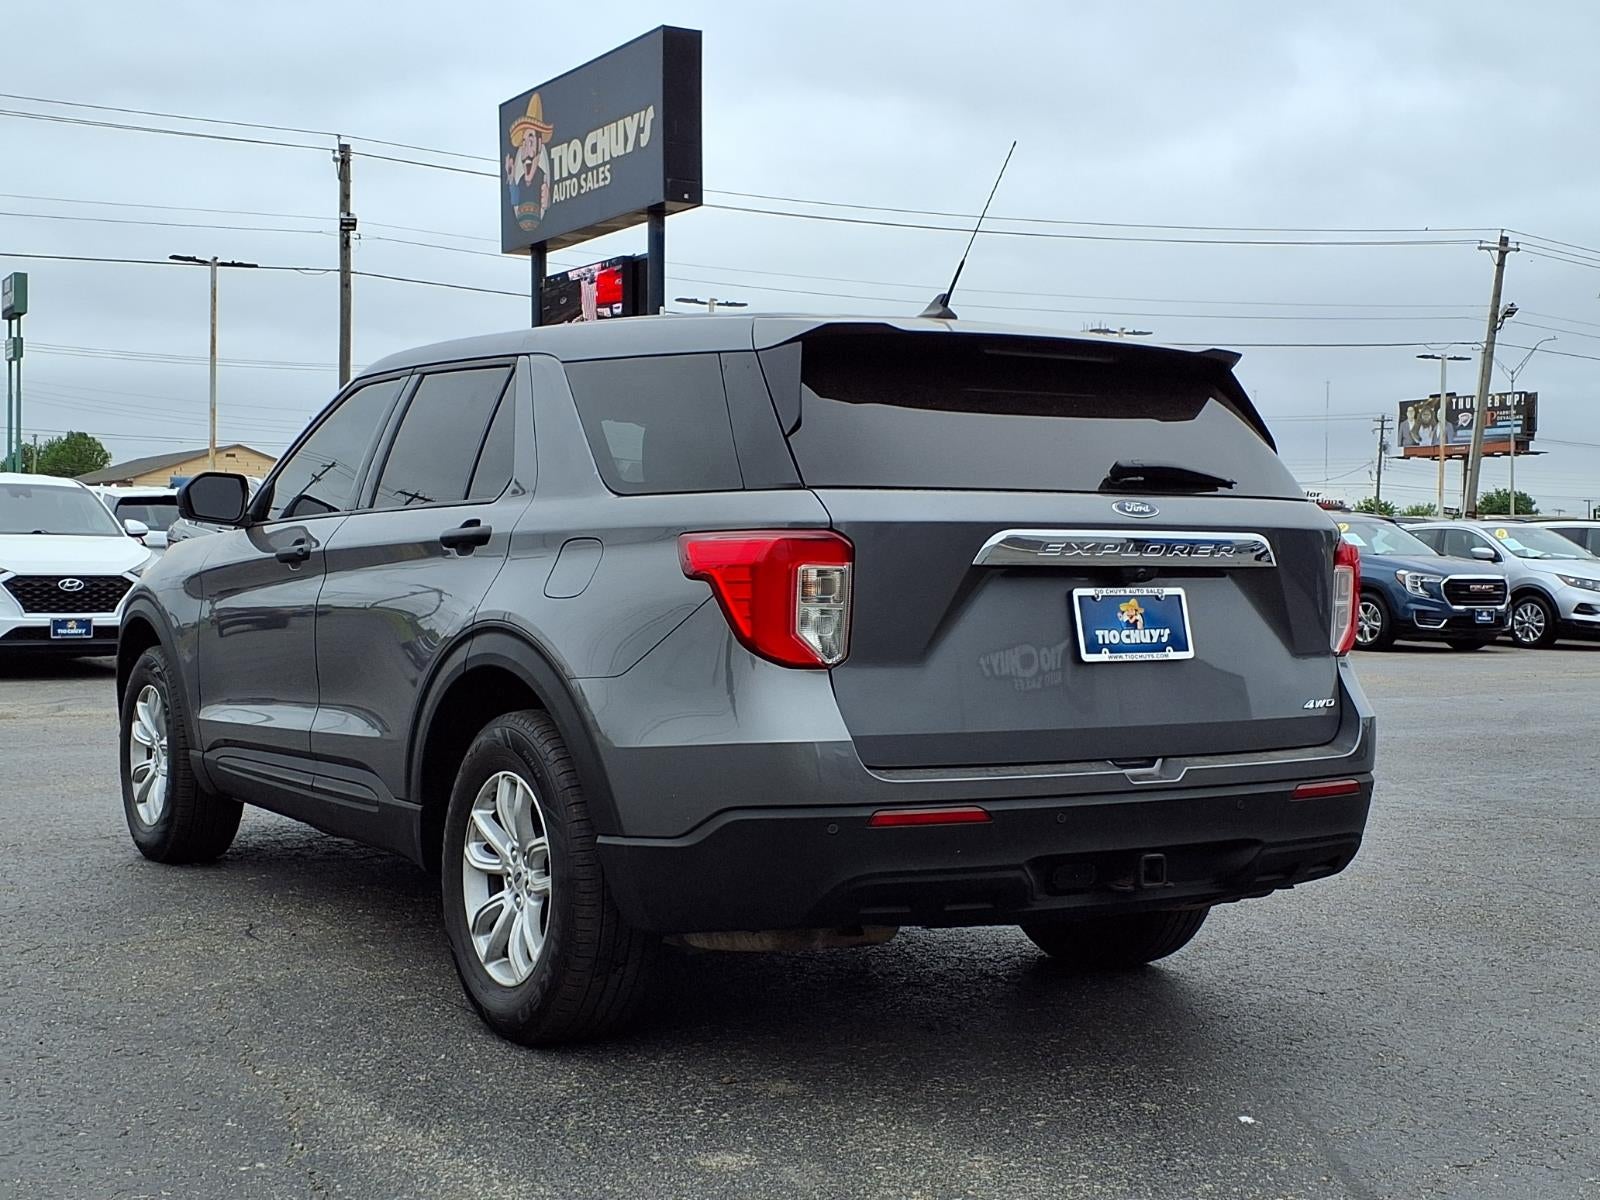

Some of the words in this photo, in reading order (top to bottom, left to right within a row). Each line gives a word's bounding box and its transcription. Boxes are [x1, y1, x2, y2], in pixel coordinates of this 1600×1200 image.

[550, 138, 583, 181] TIO
[583, 104, 655, 168] CHUY'S
[552, 177, 579, 204] AUTO
[580, 164, 611, 194] SALES
[1124, 501, 1151, 513] Ford
[1036, 542, 1237, 559] EXPLORER
[1095, 630, 1120, 644] TIO
[1120, 628, 1171, 644] CHUY'S
[1303, 698, 1335, 709] 4WD
